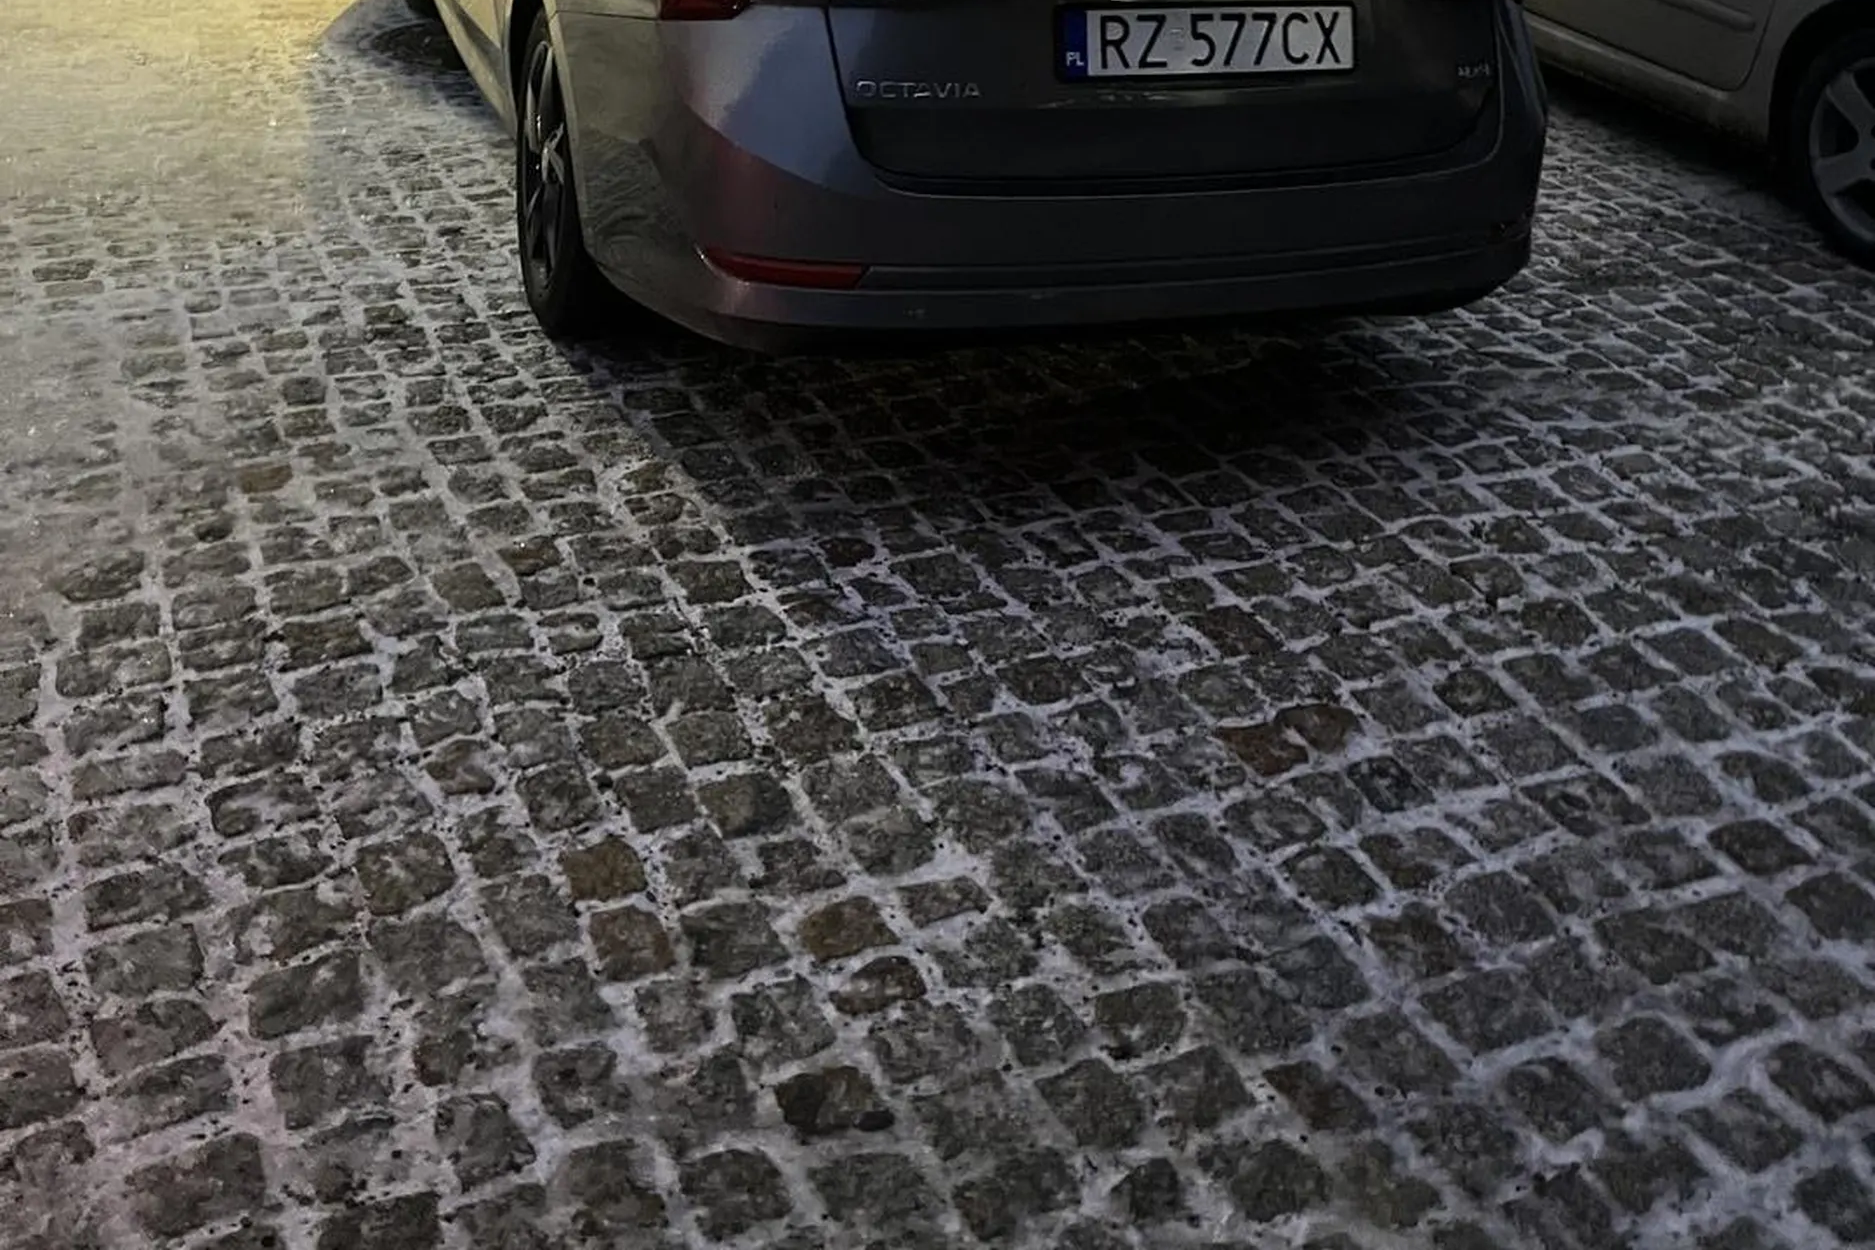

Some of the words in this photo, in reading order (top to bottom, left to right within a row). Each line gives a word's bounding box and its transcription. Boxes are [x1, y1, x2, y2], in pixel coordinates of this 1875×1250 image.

[1100, 14, 1168, 69] RZ
[1190, 11, 1340, 67] 577CX
[1065, 51, 1084, 67] PL
[856, 80, 981, 98] OCTAVIA
